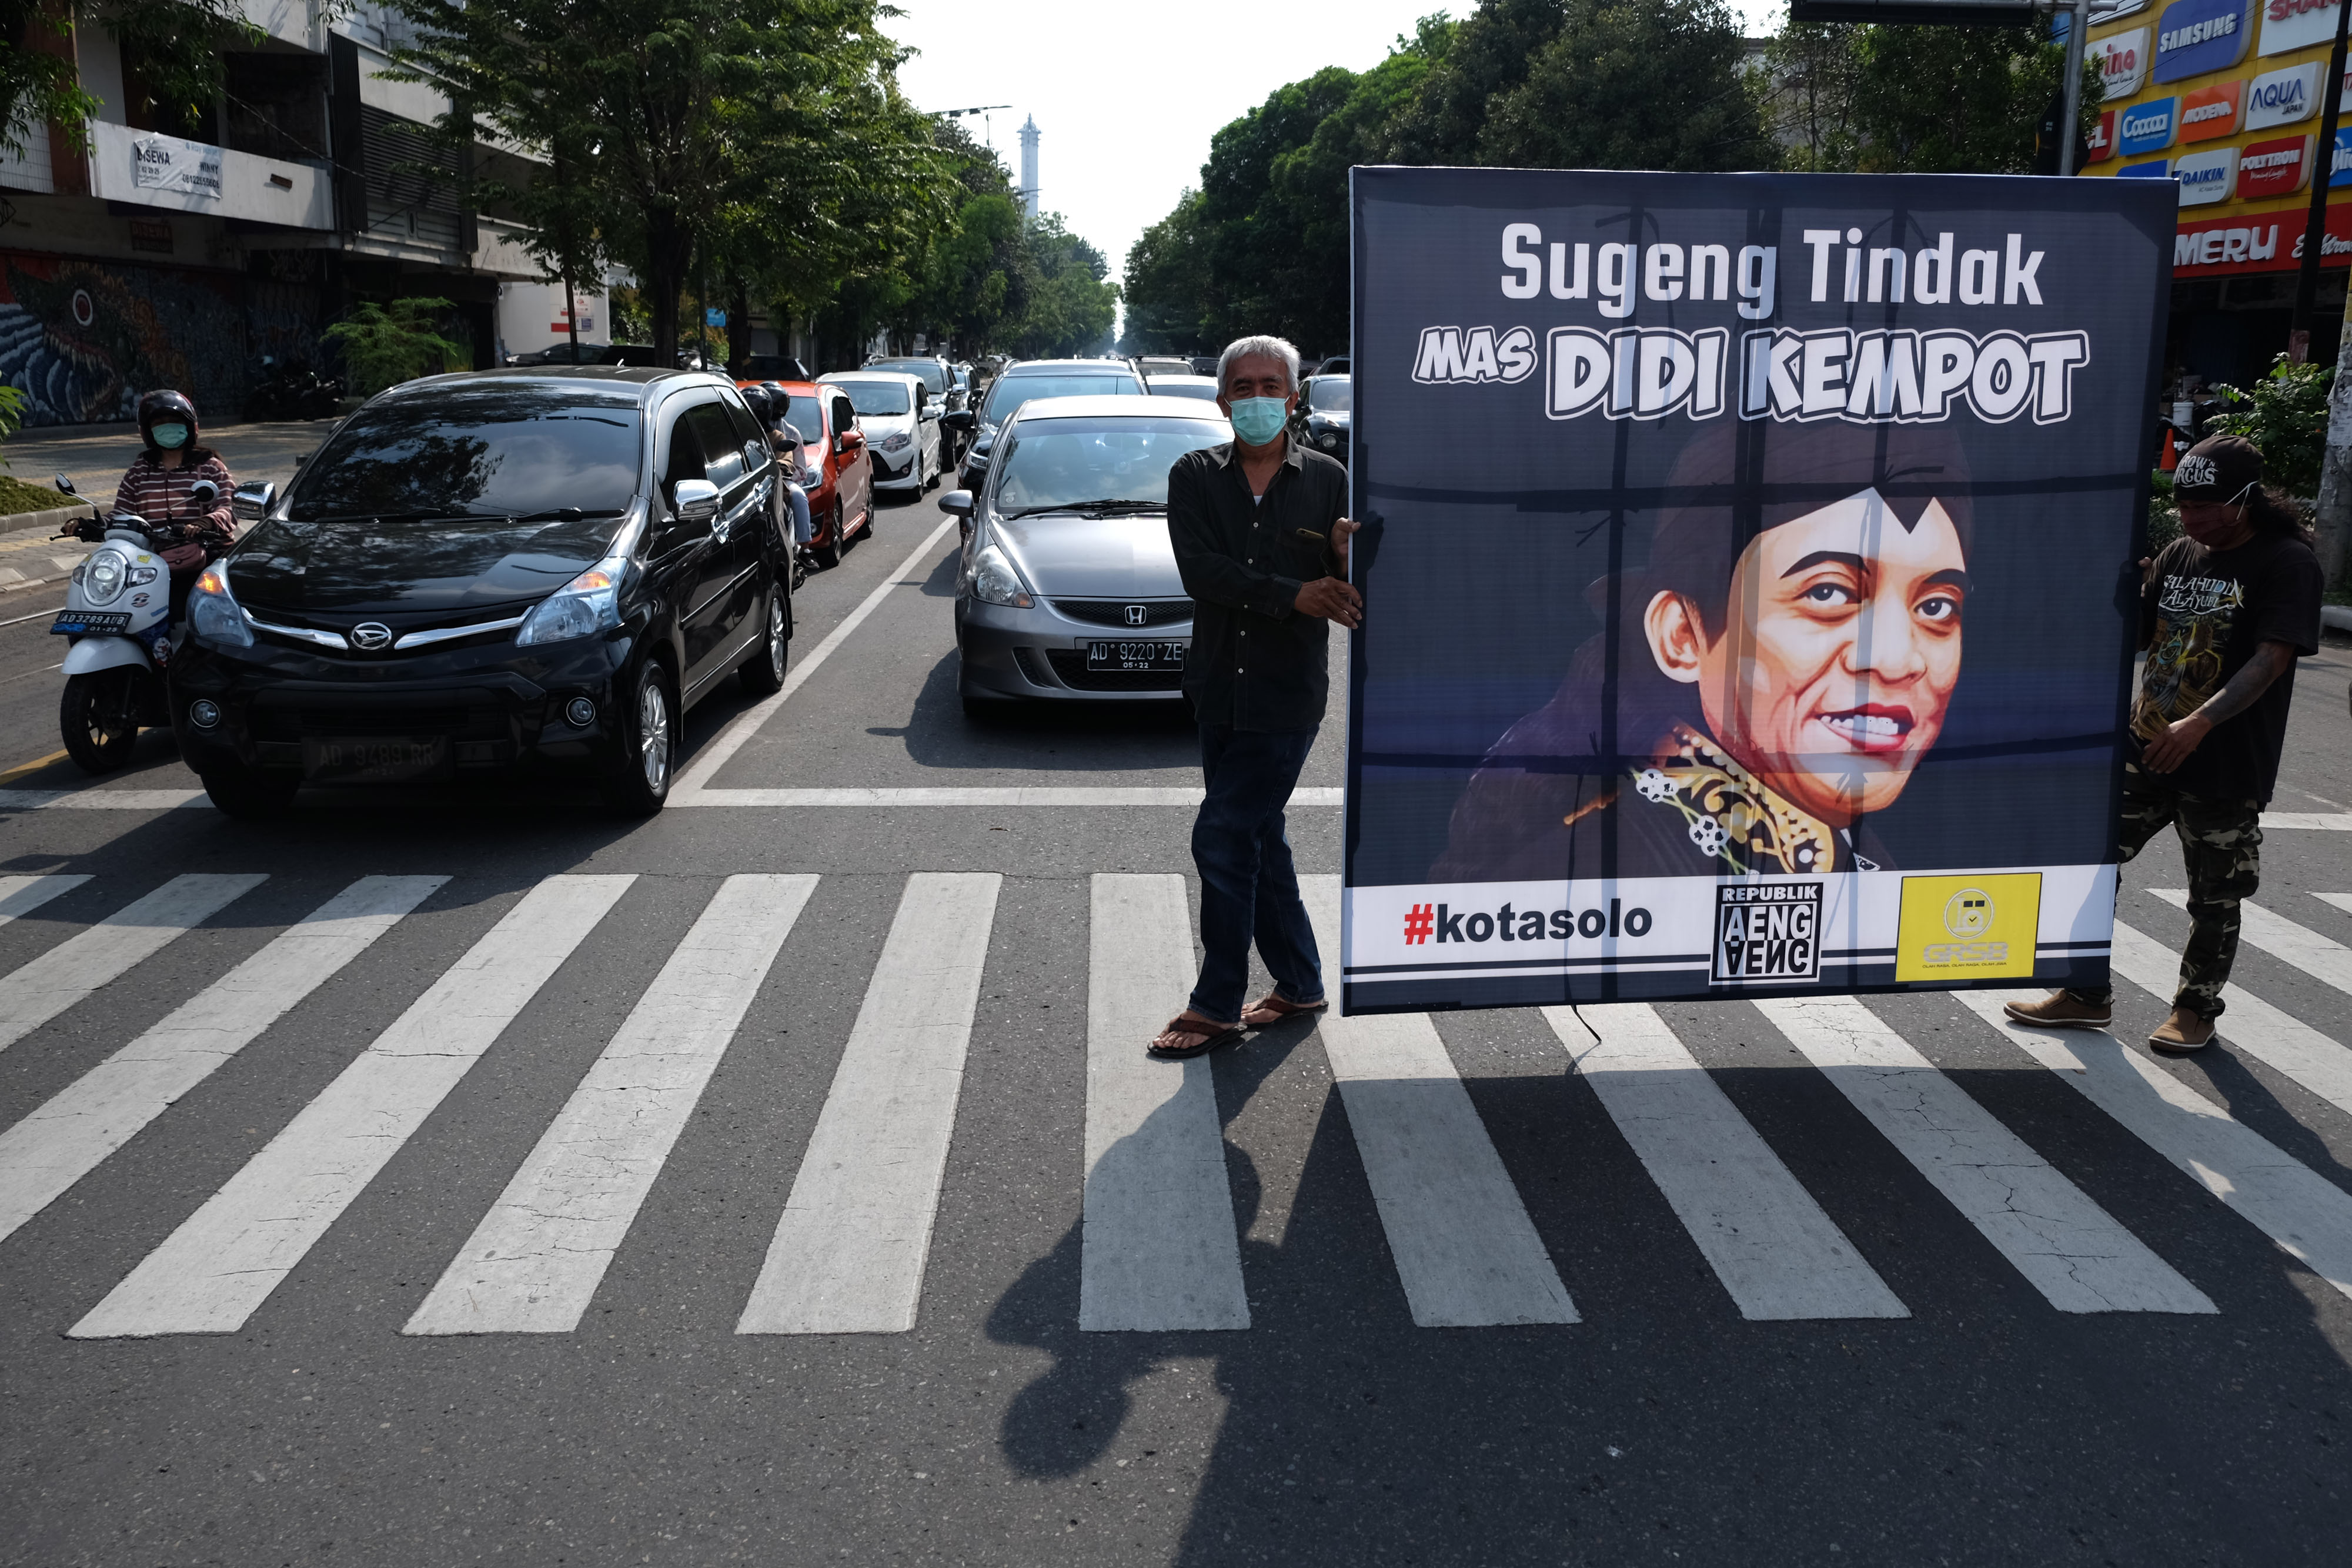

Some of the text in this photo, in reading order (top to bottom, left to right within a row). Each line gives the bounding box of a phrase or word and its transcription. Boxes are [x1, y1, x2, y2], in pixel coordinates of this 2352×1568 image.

[2160, 13, 2237, 53] SAMSUNG
[2250, 79, 2304, 111] AQUA
[2181, 101, 2232, 124] MODENA
[2282, 102, 2304, 115] JAPAN
[137, 149, 171, 166] DISEWA
[200, 161, 218, 174] WINNY
[2240, 149, 2301, 170] POLYTRON
[2182, 167, 2225, 185] DAIKIN
[2173, 225, 2278, 266] MERU
[1501, 223, 2045, 319] Sugeng Tindak
[1411, 326, 2090, 426] MAS DIDI KEMPOT
[61, 614, 76, 623] AD
[76, 615, 103, 623] 3289
[1090, 643, 1182, 660] AD 9220 ZE
[320, 743, 434, 766] AD 9489 RR
[1722, 885, 1818, 901] REPUBLIK
[1404, 898, 1652, 945] #kotasolo
[1724, 904, 1812, 942] AENG
[1923, 942, 2009, 962] GRSB
